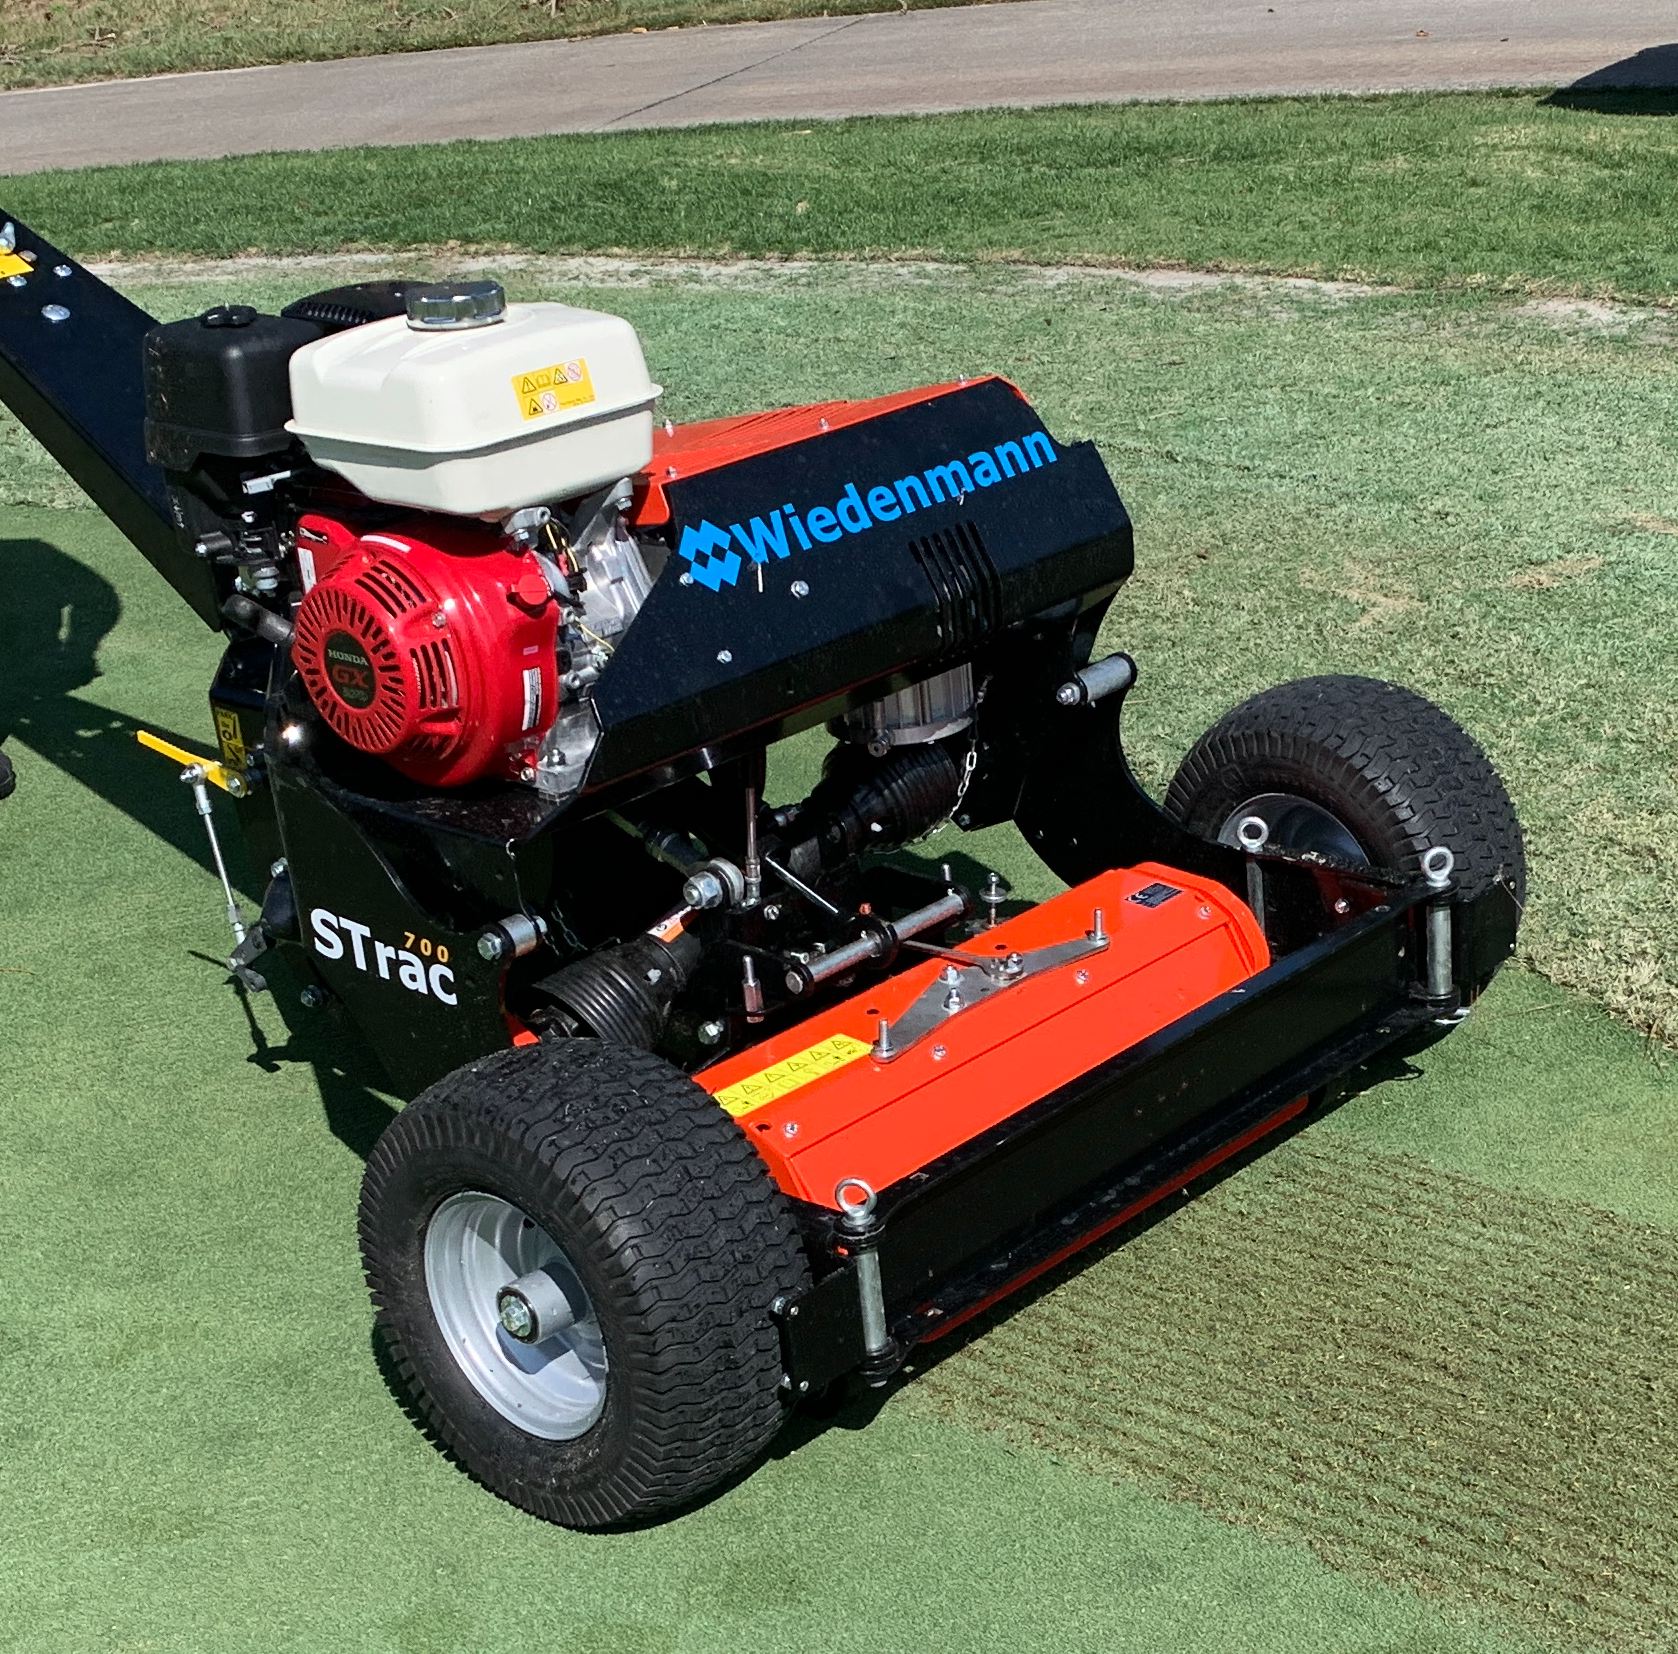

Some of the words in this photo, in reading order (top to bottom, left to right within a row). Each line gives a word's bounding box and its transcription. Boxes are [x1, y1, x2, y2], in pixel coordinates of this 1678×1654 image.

[730, 430, 1057, 563] Wiedenmann
[327, 648, 369, 666] HONDA
[332, 664, 369, 689] GX
[310, 908, 458, 1006] STrac
[404, 931, 449, 963] 700
